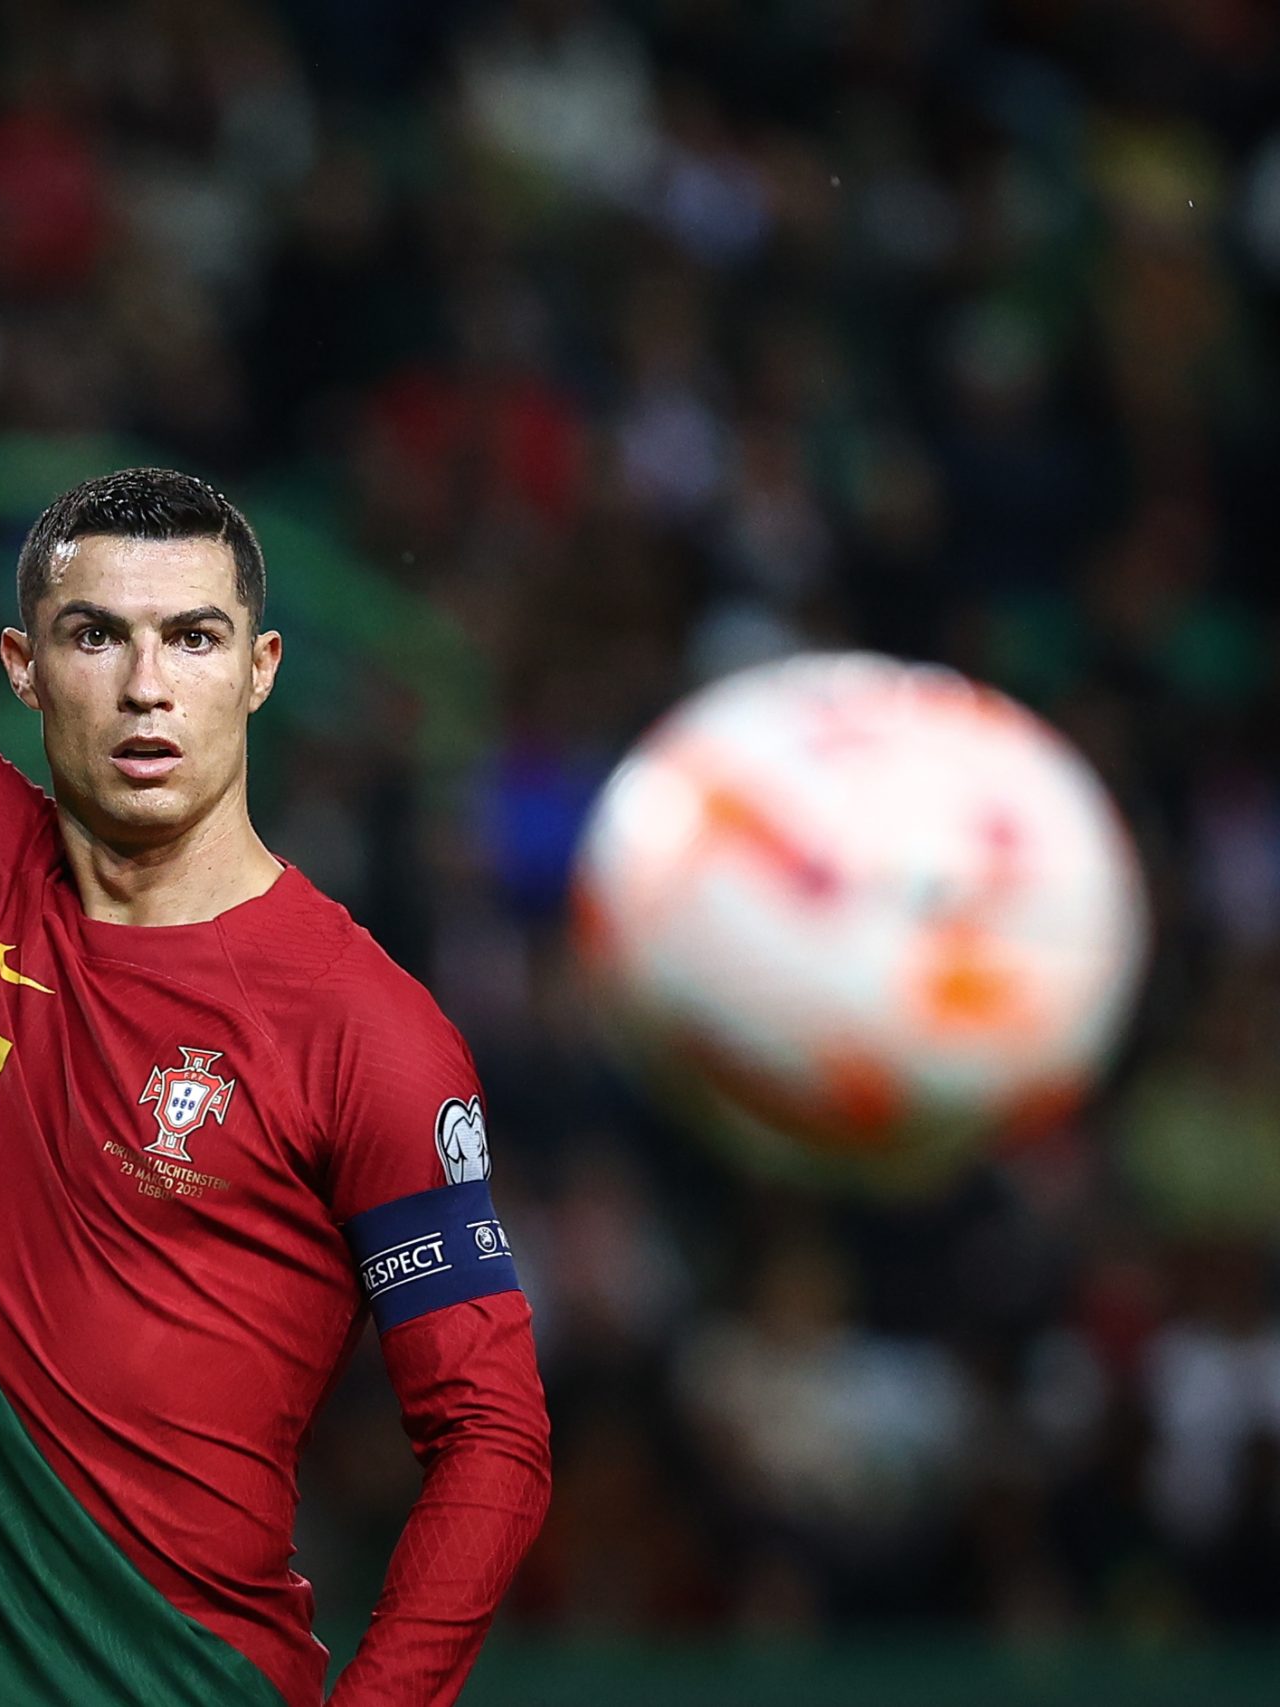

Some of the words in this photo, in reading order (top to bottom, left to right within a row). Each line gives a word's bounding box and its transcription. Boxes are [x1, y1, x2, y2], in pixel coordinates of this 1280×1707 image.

[119, 1161, 134, 1175] 23
[175, 1181, 204, 1199] 2023
[362, 1240, 444, 1291] RESPECT
